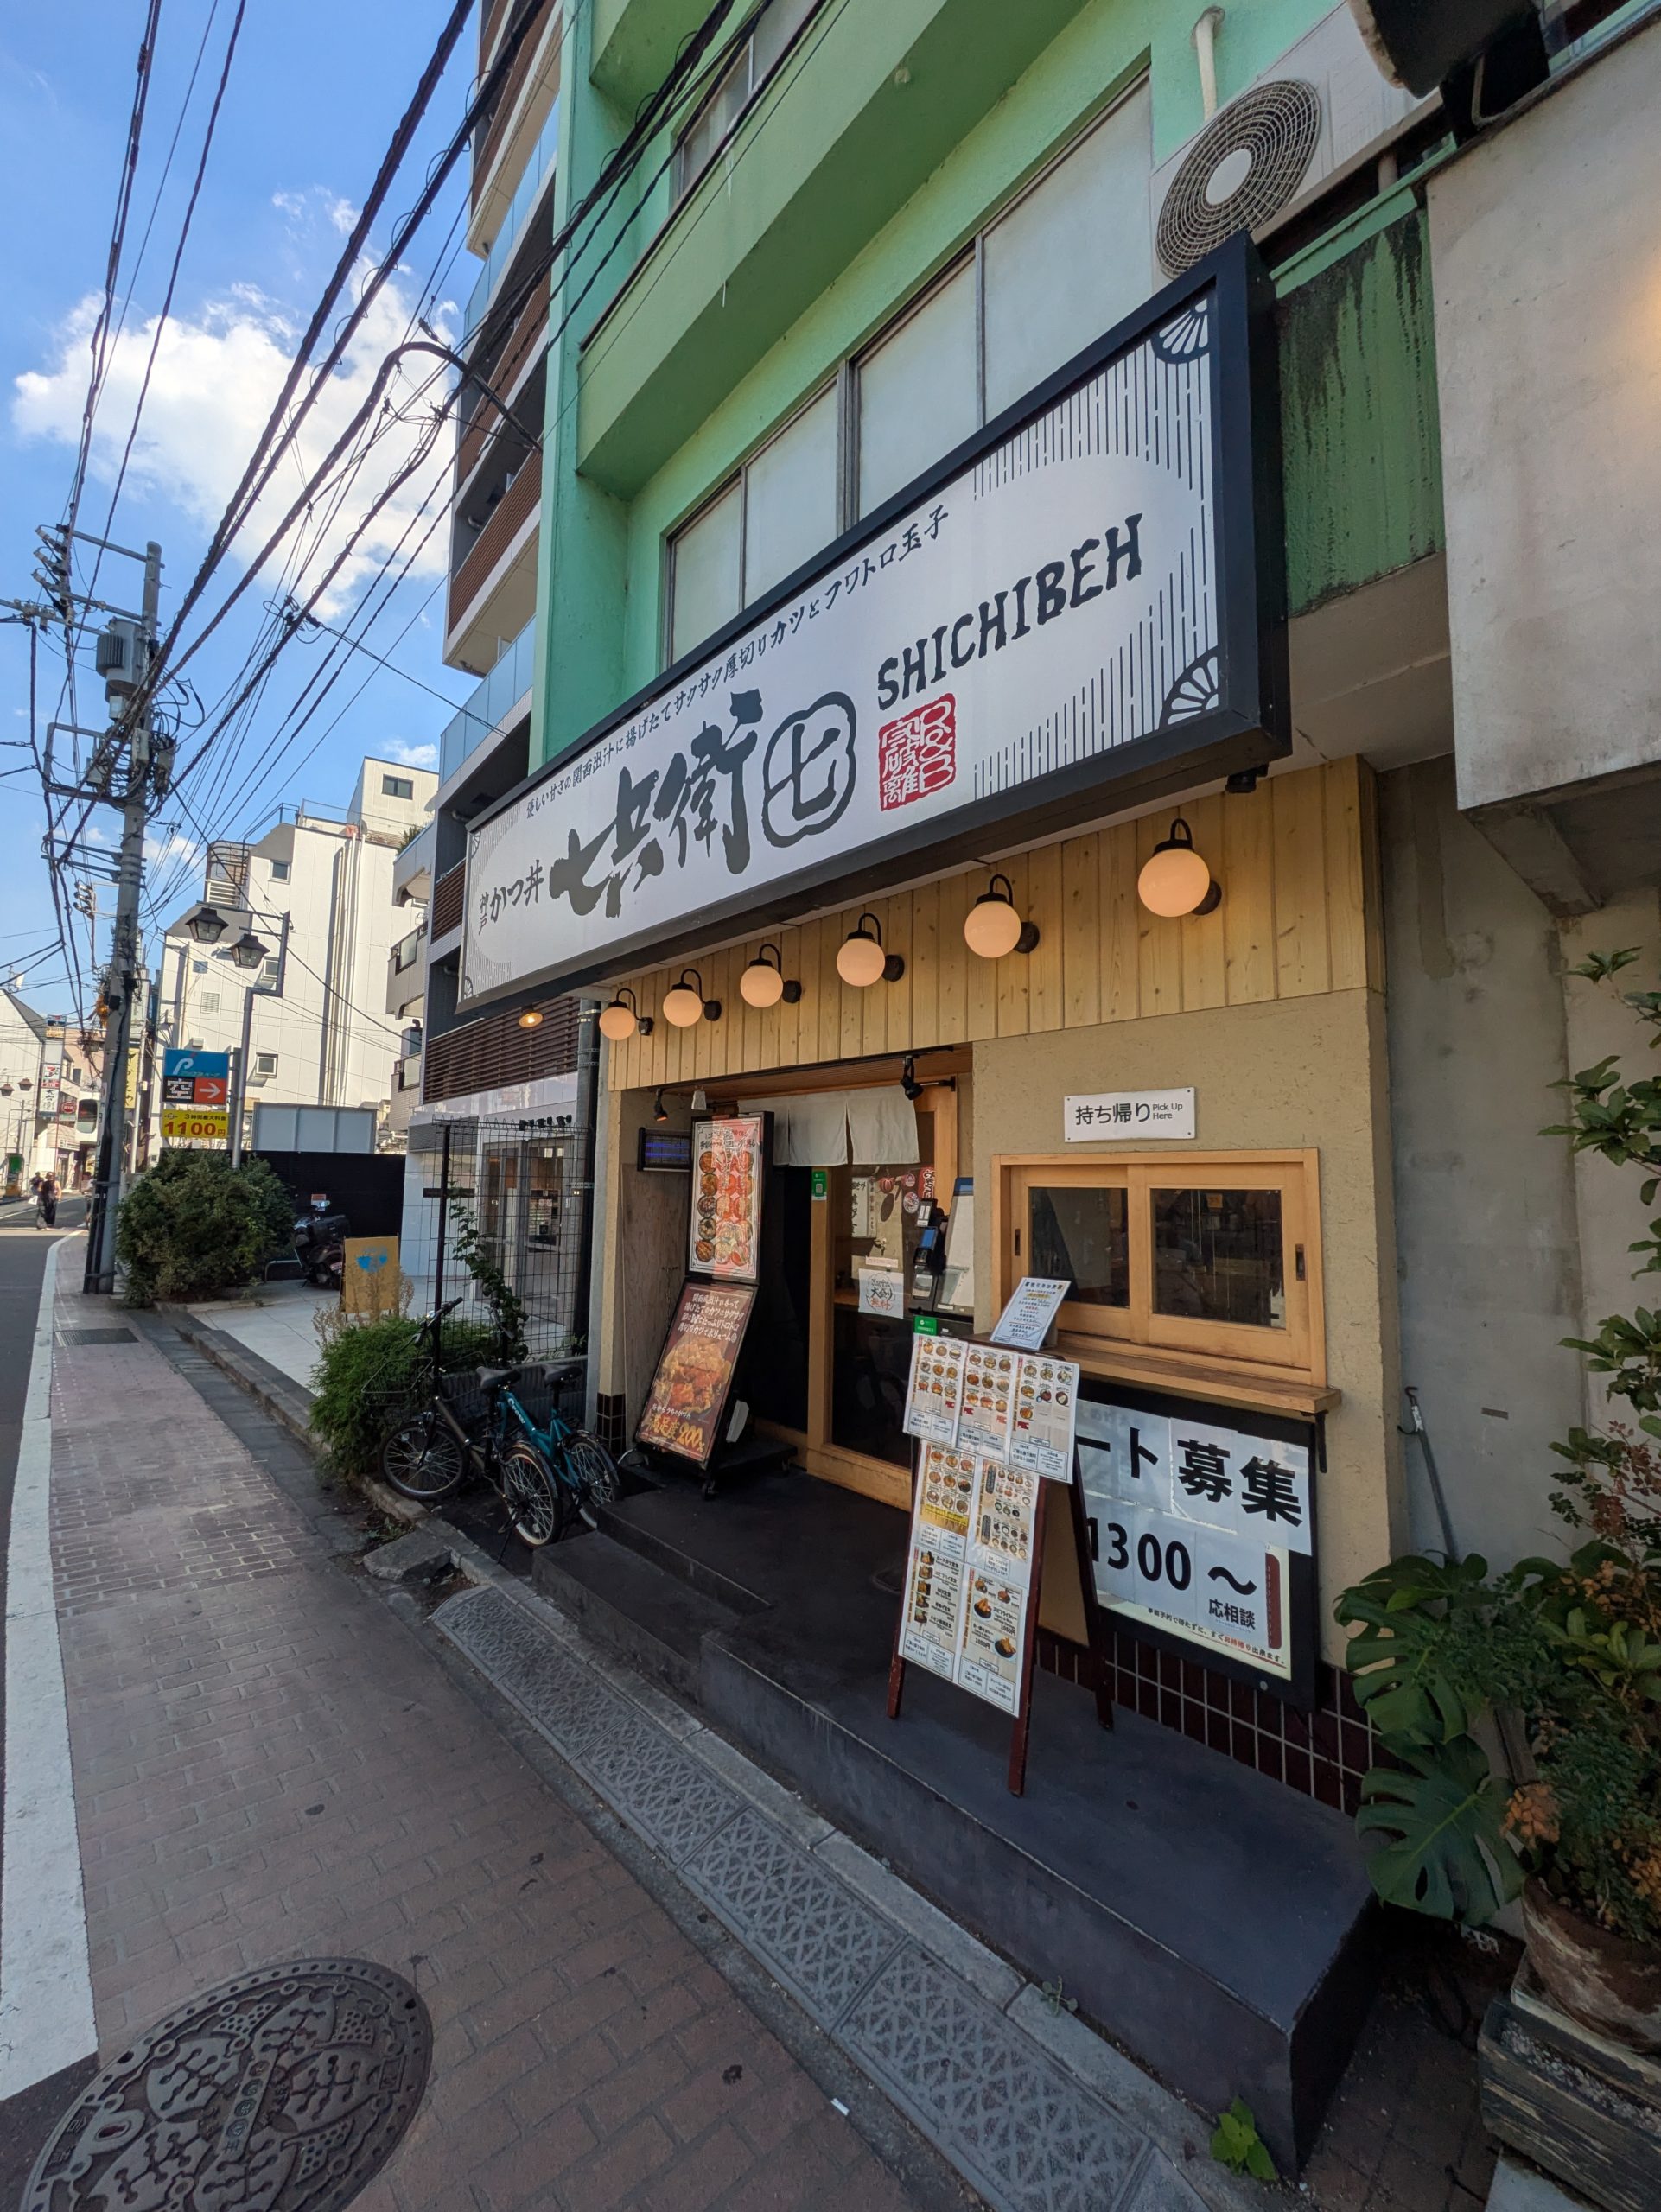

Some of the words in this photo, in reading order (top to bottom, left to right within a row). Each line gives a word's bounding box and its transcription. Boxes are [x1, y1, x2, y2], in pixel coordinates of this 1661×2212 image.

[877, 512, 1143, 711] SHICHIBEH
[550, 688, 764, 918] 七兵衛
[489, 859, 545, 924] かつ丼
[166, 1077, 194, 1100] 空
[164, 1120, 226, 1136] 1100円
[1075, 1103, 1151, 1126] 持ち帰り
[1171, 1103, 1183, 1112] Up
[1208, 1599, 1257, 1630] 応相談
